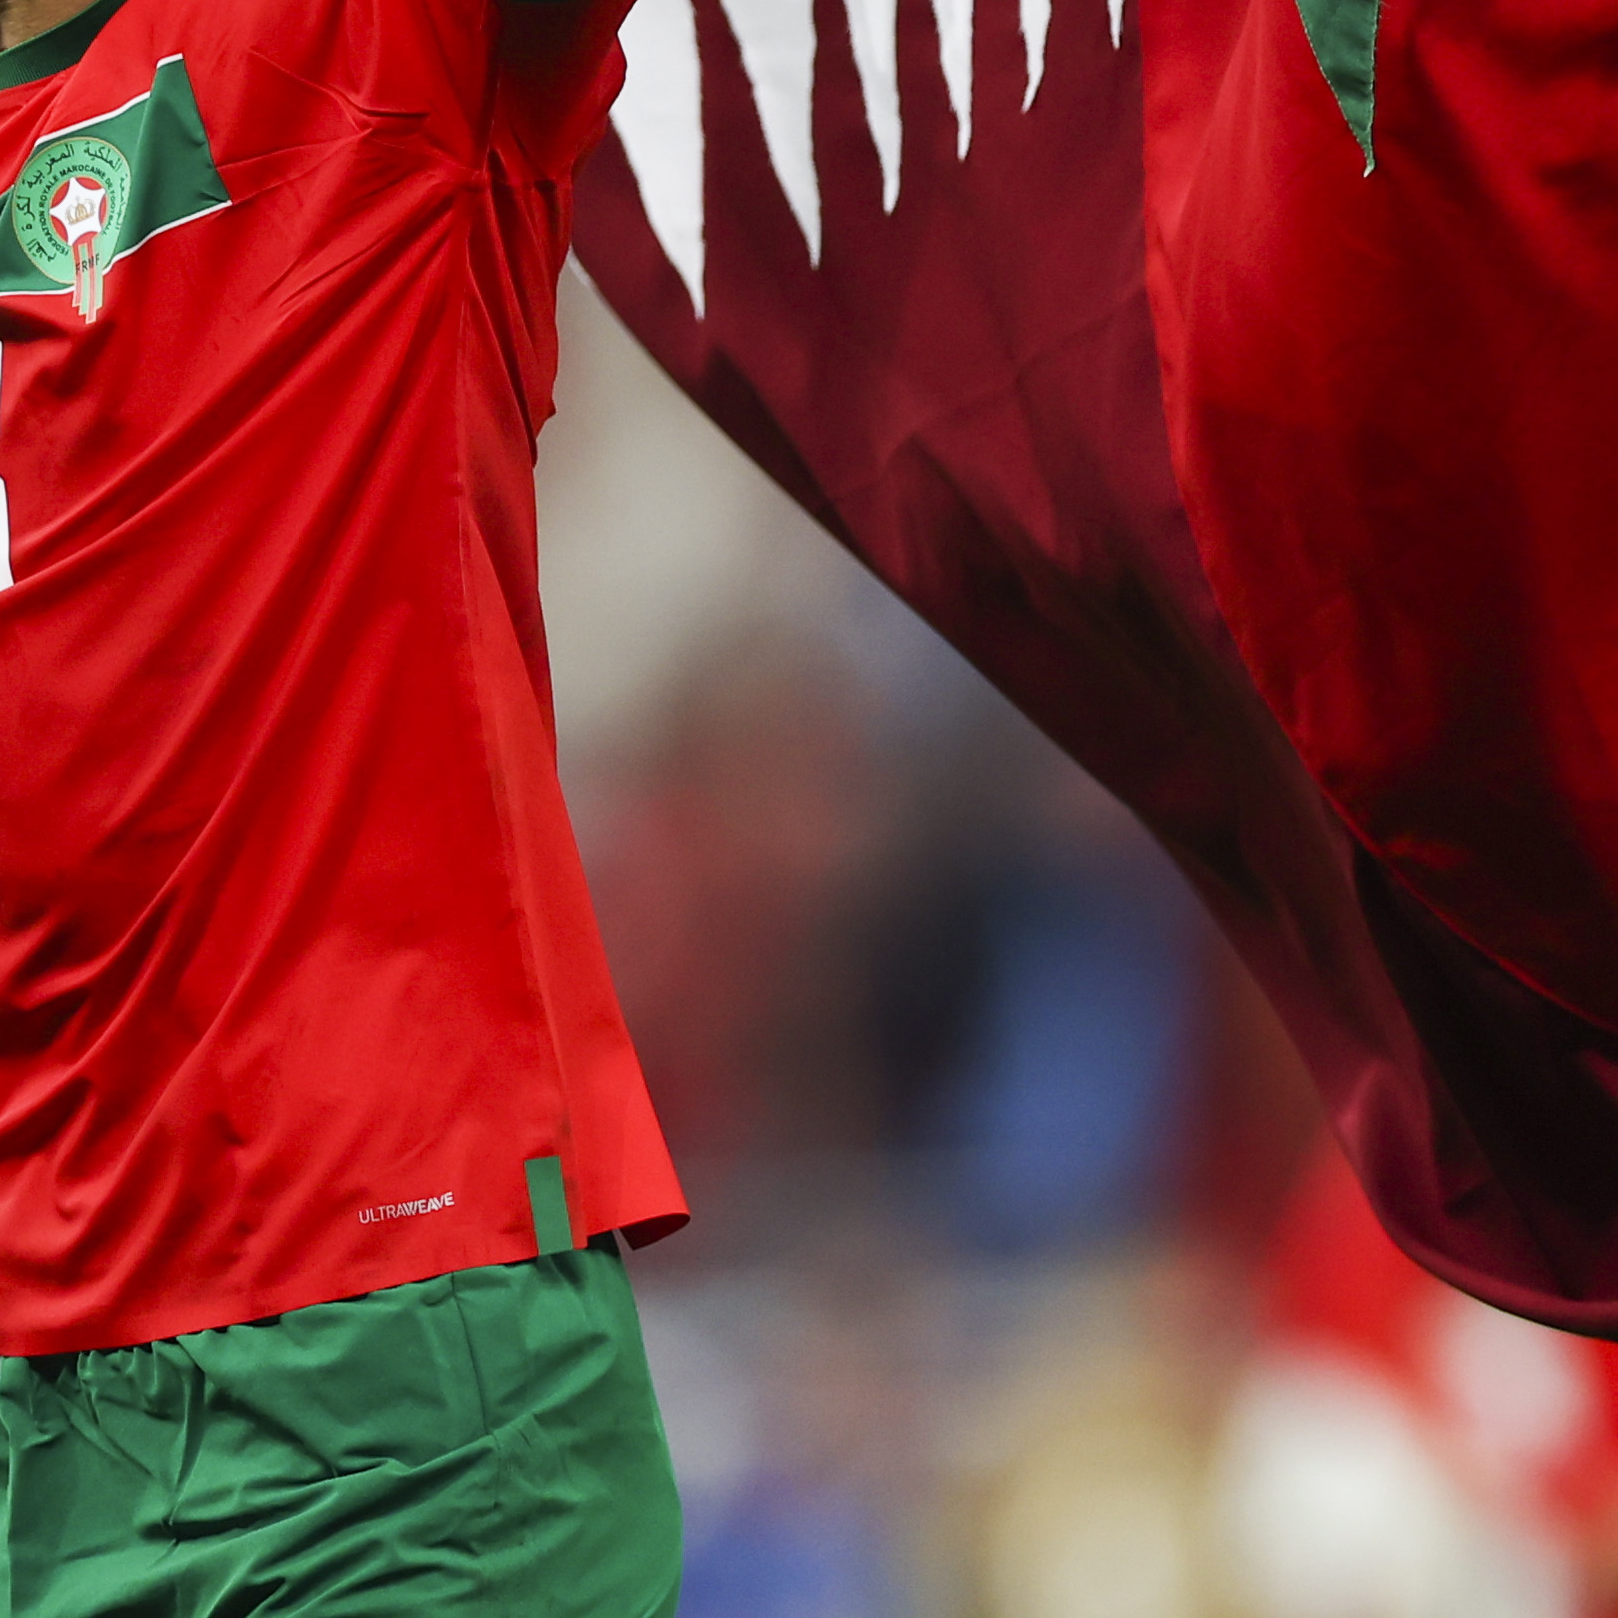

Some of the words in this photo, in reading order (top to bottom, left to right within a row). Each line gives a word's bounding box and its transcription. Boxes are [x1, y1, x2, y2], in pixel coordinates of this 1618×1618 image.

[22, 142, 75, 188] المغربية
[59, 164, 106, 180] MAROCAINE
[83, 140, 123, 172] الملكية
[38, 176, 59, 208] ROYALE
[104, 178, 114, 189] DE
[38, 210, 69, 257] FEDERATION
[358, 1191, 455, 1224] ULTRAWEAVE
